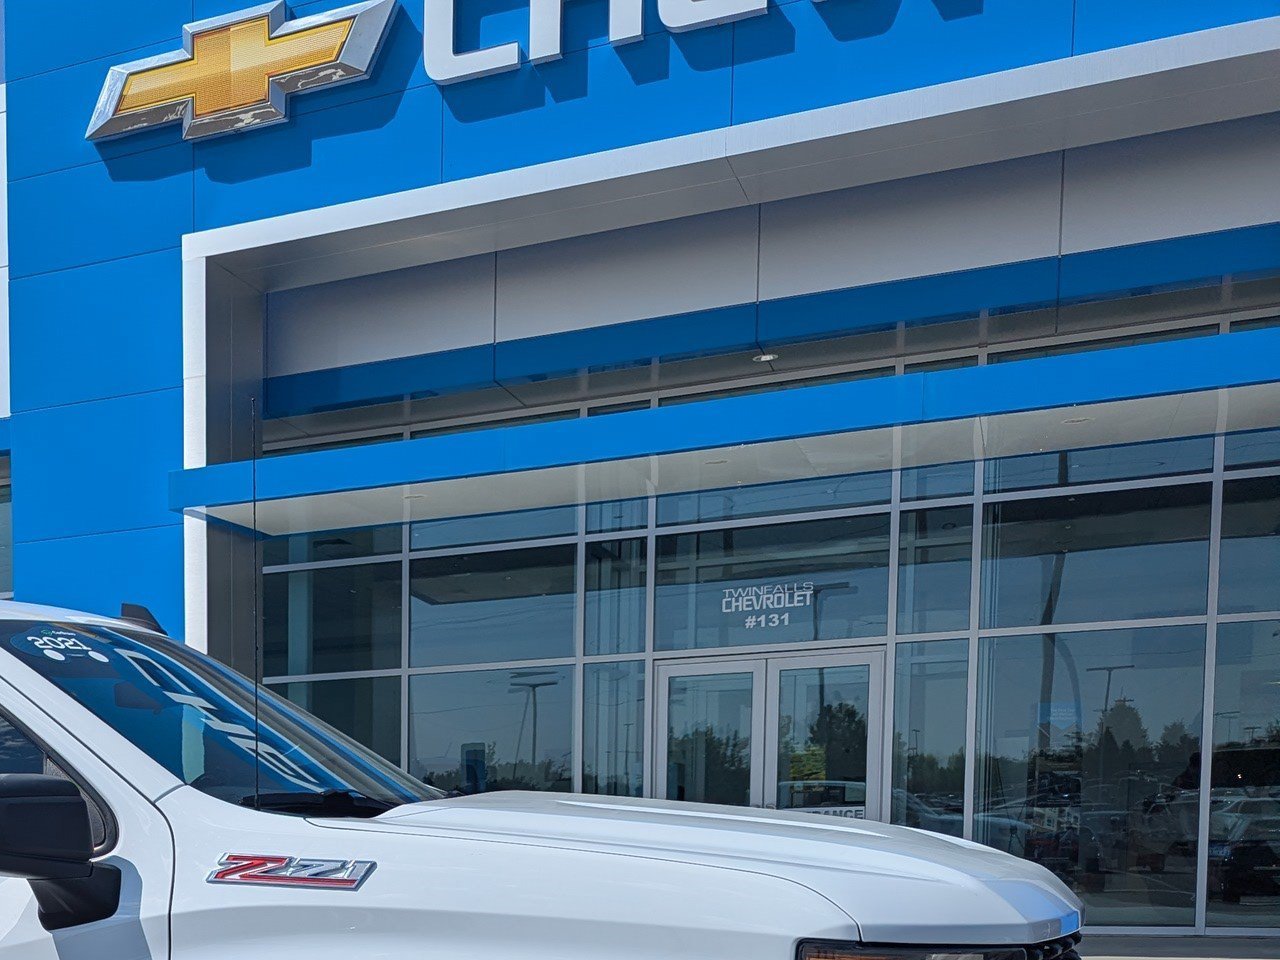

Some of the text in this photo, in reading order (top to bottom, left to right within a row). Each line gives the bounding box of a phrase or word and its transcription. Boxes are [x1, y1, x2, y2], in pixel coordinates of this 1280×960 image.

[721, 590, 814, 613] CHEVROLET
[744, 612, 790, 629] #131
[26, 636, 92, 651] 2021
[206, 852, 377, 892] Z71
